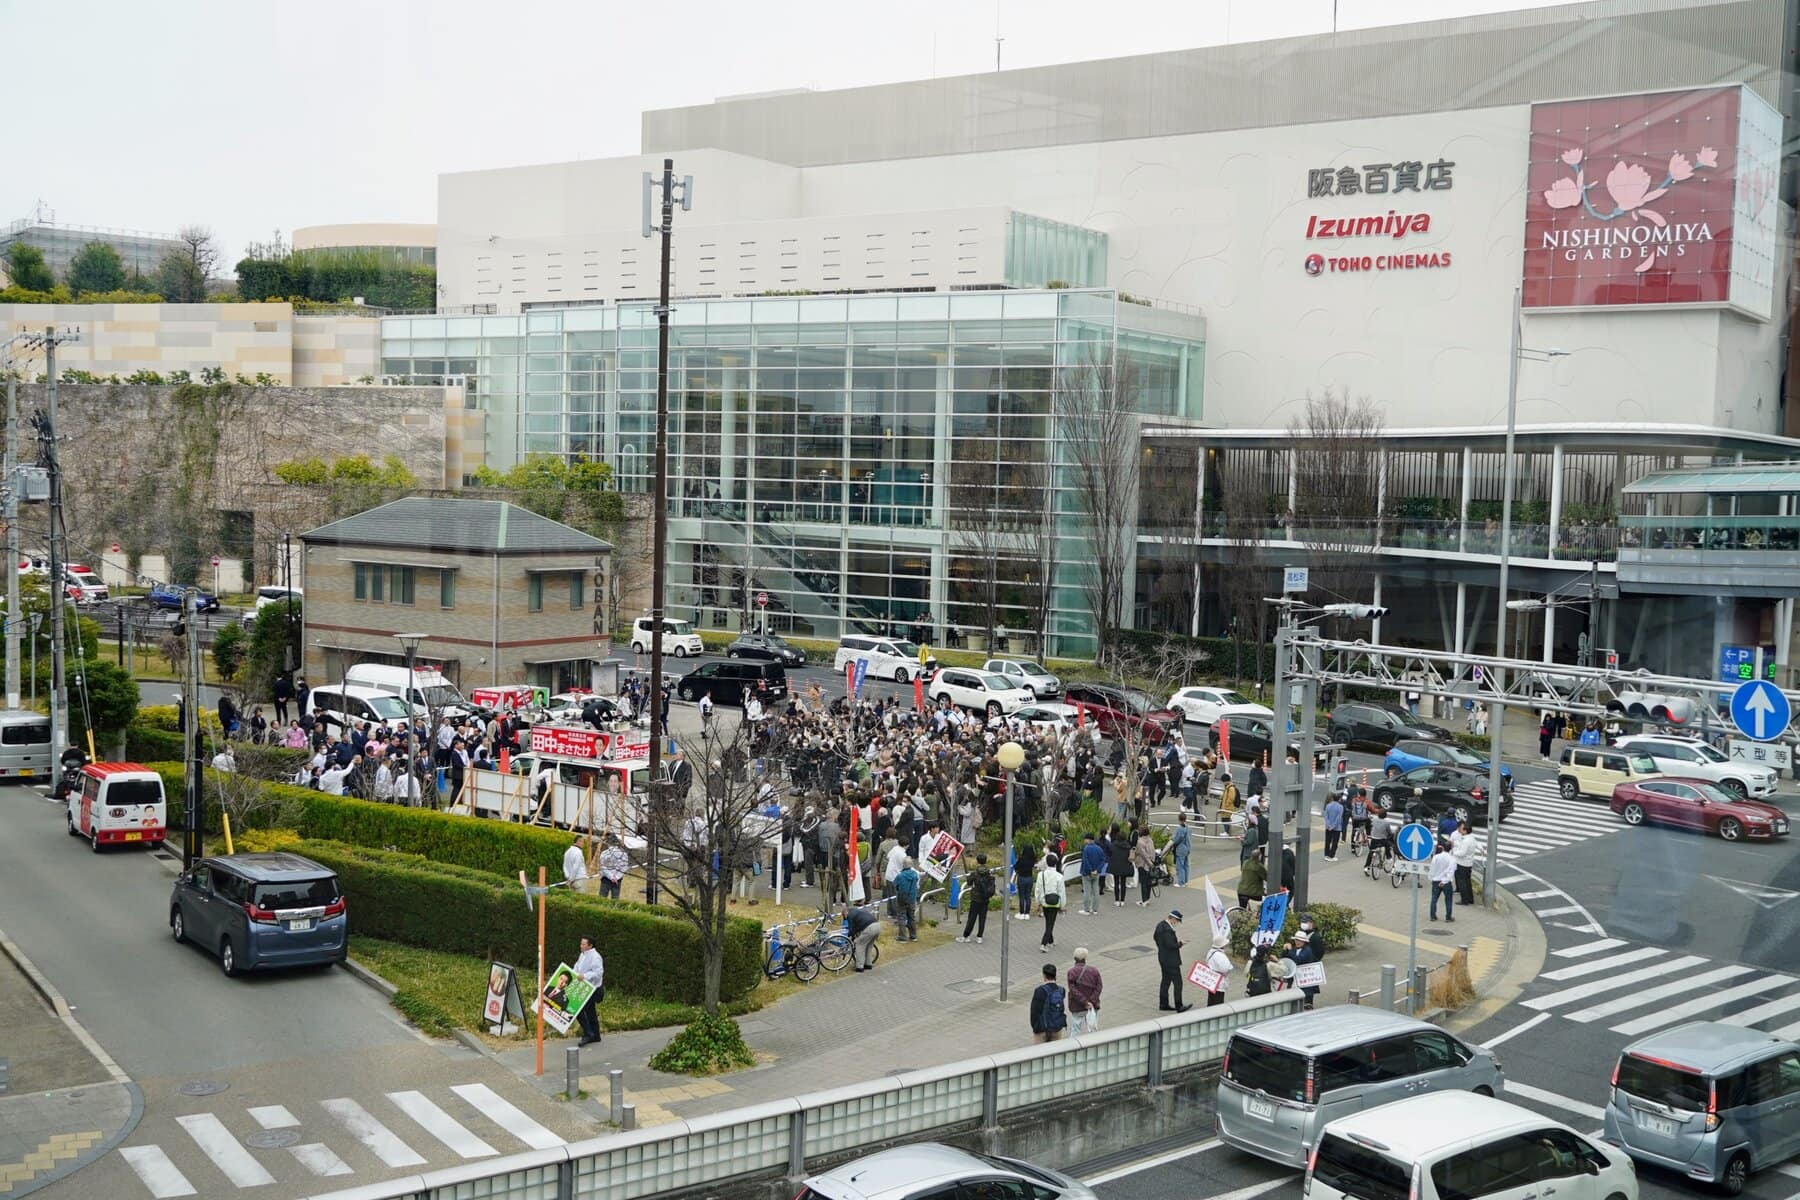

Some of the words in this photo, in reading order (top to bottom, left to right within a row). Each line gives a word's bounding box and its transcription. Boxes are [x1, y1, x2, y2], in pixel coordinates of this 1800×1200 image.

[1308, 158, 1455, 198] 阪急百貨店
[1306, 210, 1430, 239] Izumiya
[1542, 222, 1712, 248] NISHINOMIYA
[1328, 256, 1372, 272] TOHO
[1376, 253, 1451, 270] CINEMAS
[1565, 244, 1686, 261] GARDENS
[593, 556, 604, 635] KOBAN
[1738, 650, 1749, 661] P
[1738, 663, 1752, 679] 空
[532, 734, 591, 757] 田中まさたけ
[1732, 745, 1788, 763] 大型等
